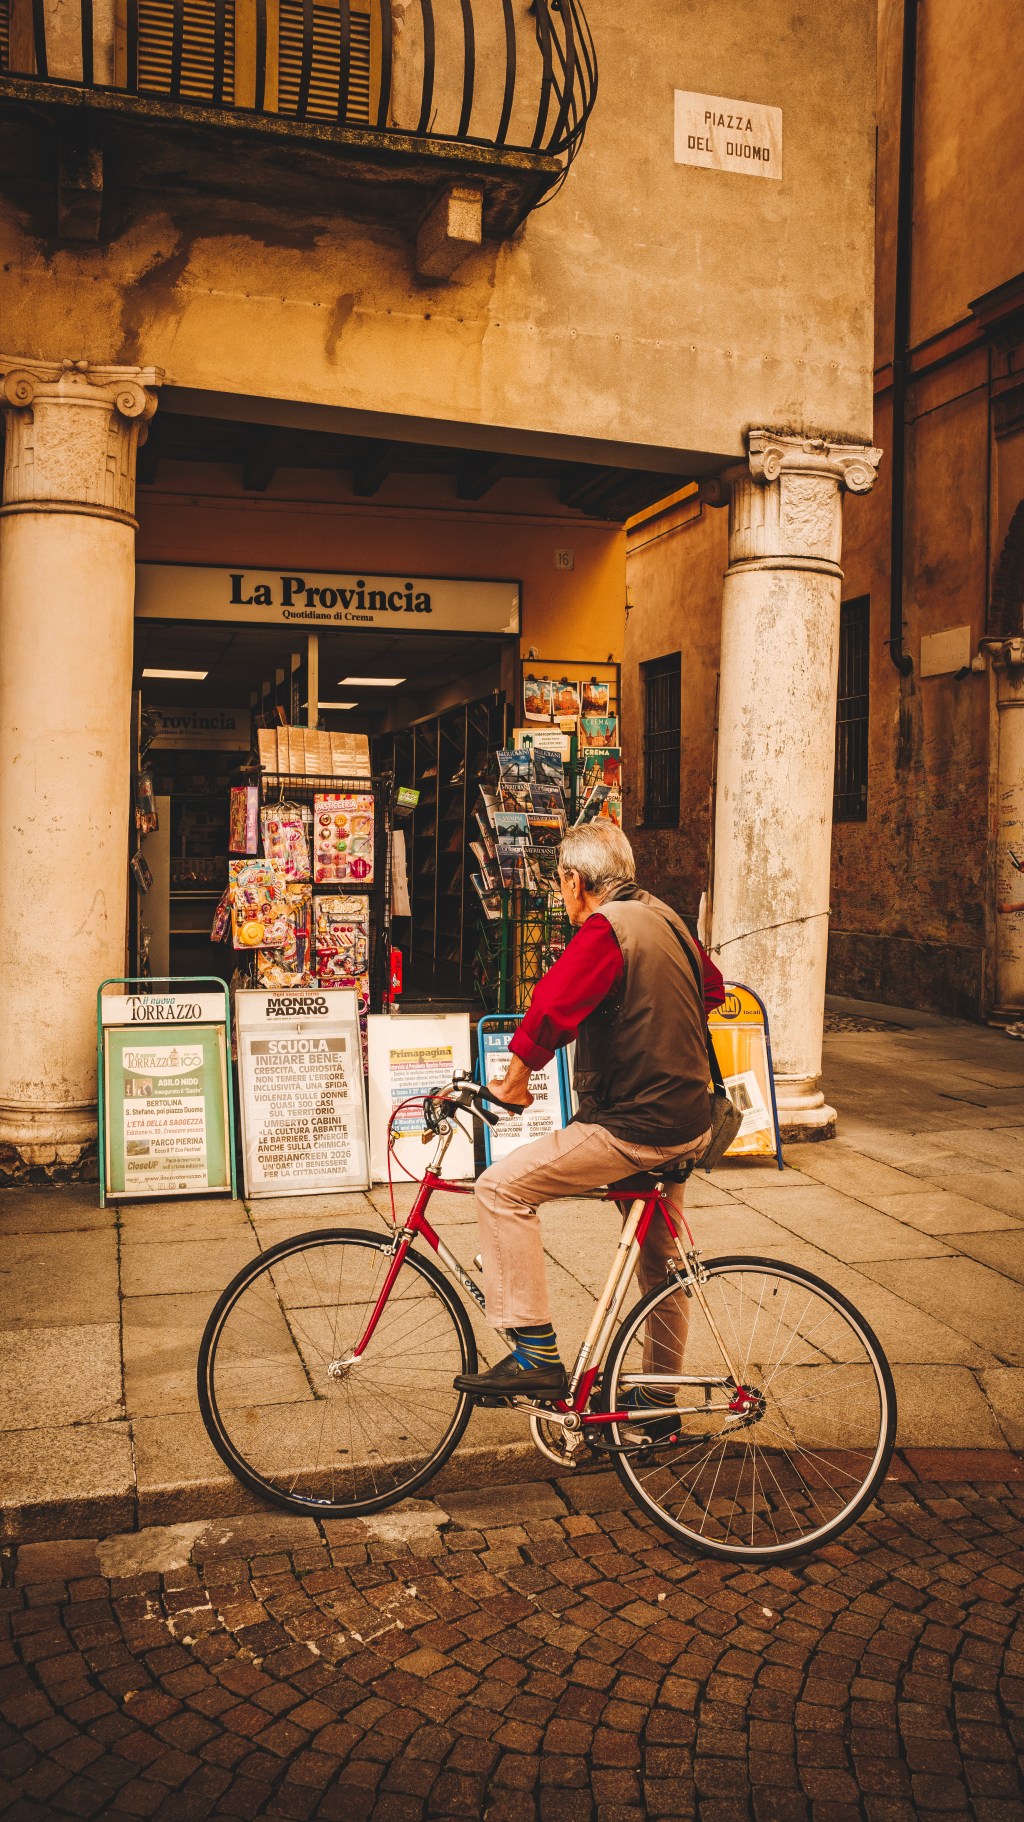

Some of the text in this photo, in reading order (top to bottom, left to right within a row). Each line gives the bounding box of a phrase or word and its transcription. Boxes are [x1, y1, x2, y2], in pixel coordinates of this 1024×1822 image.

[705, 111, 752, 132] PIAZZA
[688, 136, 770, 162] DEL DUOMO
[559, 553, 568, 566] 16
[230, 574, 432, 614] La Provincia
[282, 610, 374, 622] Quotidiano di Crema
[143, 996, 149, 1004] il
[268, 996, 326, 1007] MONDO
[126, 996, 202, 1020] TORRAZZO
[266, 1006, 329, 1016] PADANO
[488, 1036, 501, 1046] La
[268, 1040, 330, 1054] SCUOLA
[390, 1048, 452, 1058] Primapagina
[256, 1054, 342, 1066] INIZIARE BENE:
[254, 1063, 344, 1075] CRESCITA, CURIOSITÀ,
[158, 1079, 180, 1087] ASILO
[276, 1074, 306, 1082] TEMERE
[254, 1082, 303, 1092] INCLUSIVITÀ,
[324, 1081, 348, 1089] SFIDA
[254, 1090, 348, 1102] VIOLENZA SULLE DONNE
[270, 1101, 295, 1110] QUASI
[132, 1108, 156, 1116] Stefano,
[156, 1108, 166, 1116] poi
[166, 1107, 184, 1116] piazza
[269, 1108, 336, 1118] SUL TERRITORIO
[169, 1118, 204, 1126] SAGGEZZA
[264, 1116, 342, 1128] UMBERTO CABINI
[274, 1126, 310, 1136] CULTURA
[312, 1124, 348, 1133] ABBATTE
[151, 1138, 204, 1147] PARCO PIERINA
[270, 1134, 310, 1144] BARRIERE.
[314, 1132, 348, 1141] SINERGIE
[258, 1144, 285, 1152] ANCHE
[287, 1142, 312, 1150] SULLA
[258, 1150, 352, 1164] OMBRIANGREEN 2026
[262, 1162, 294, 1170] UN'OASI
[306, 1159, 348, 1168] BENESSERE
[292, 1166, 347, 1176] CITTADINANZA
